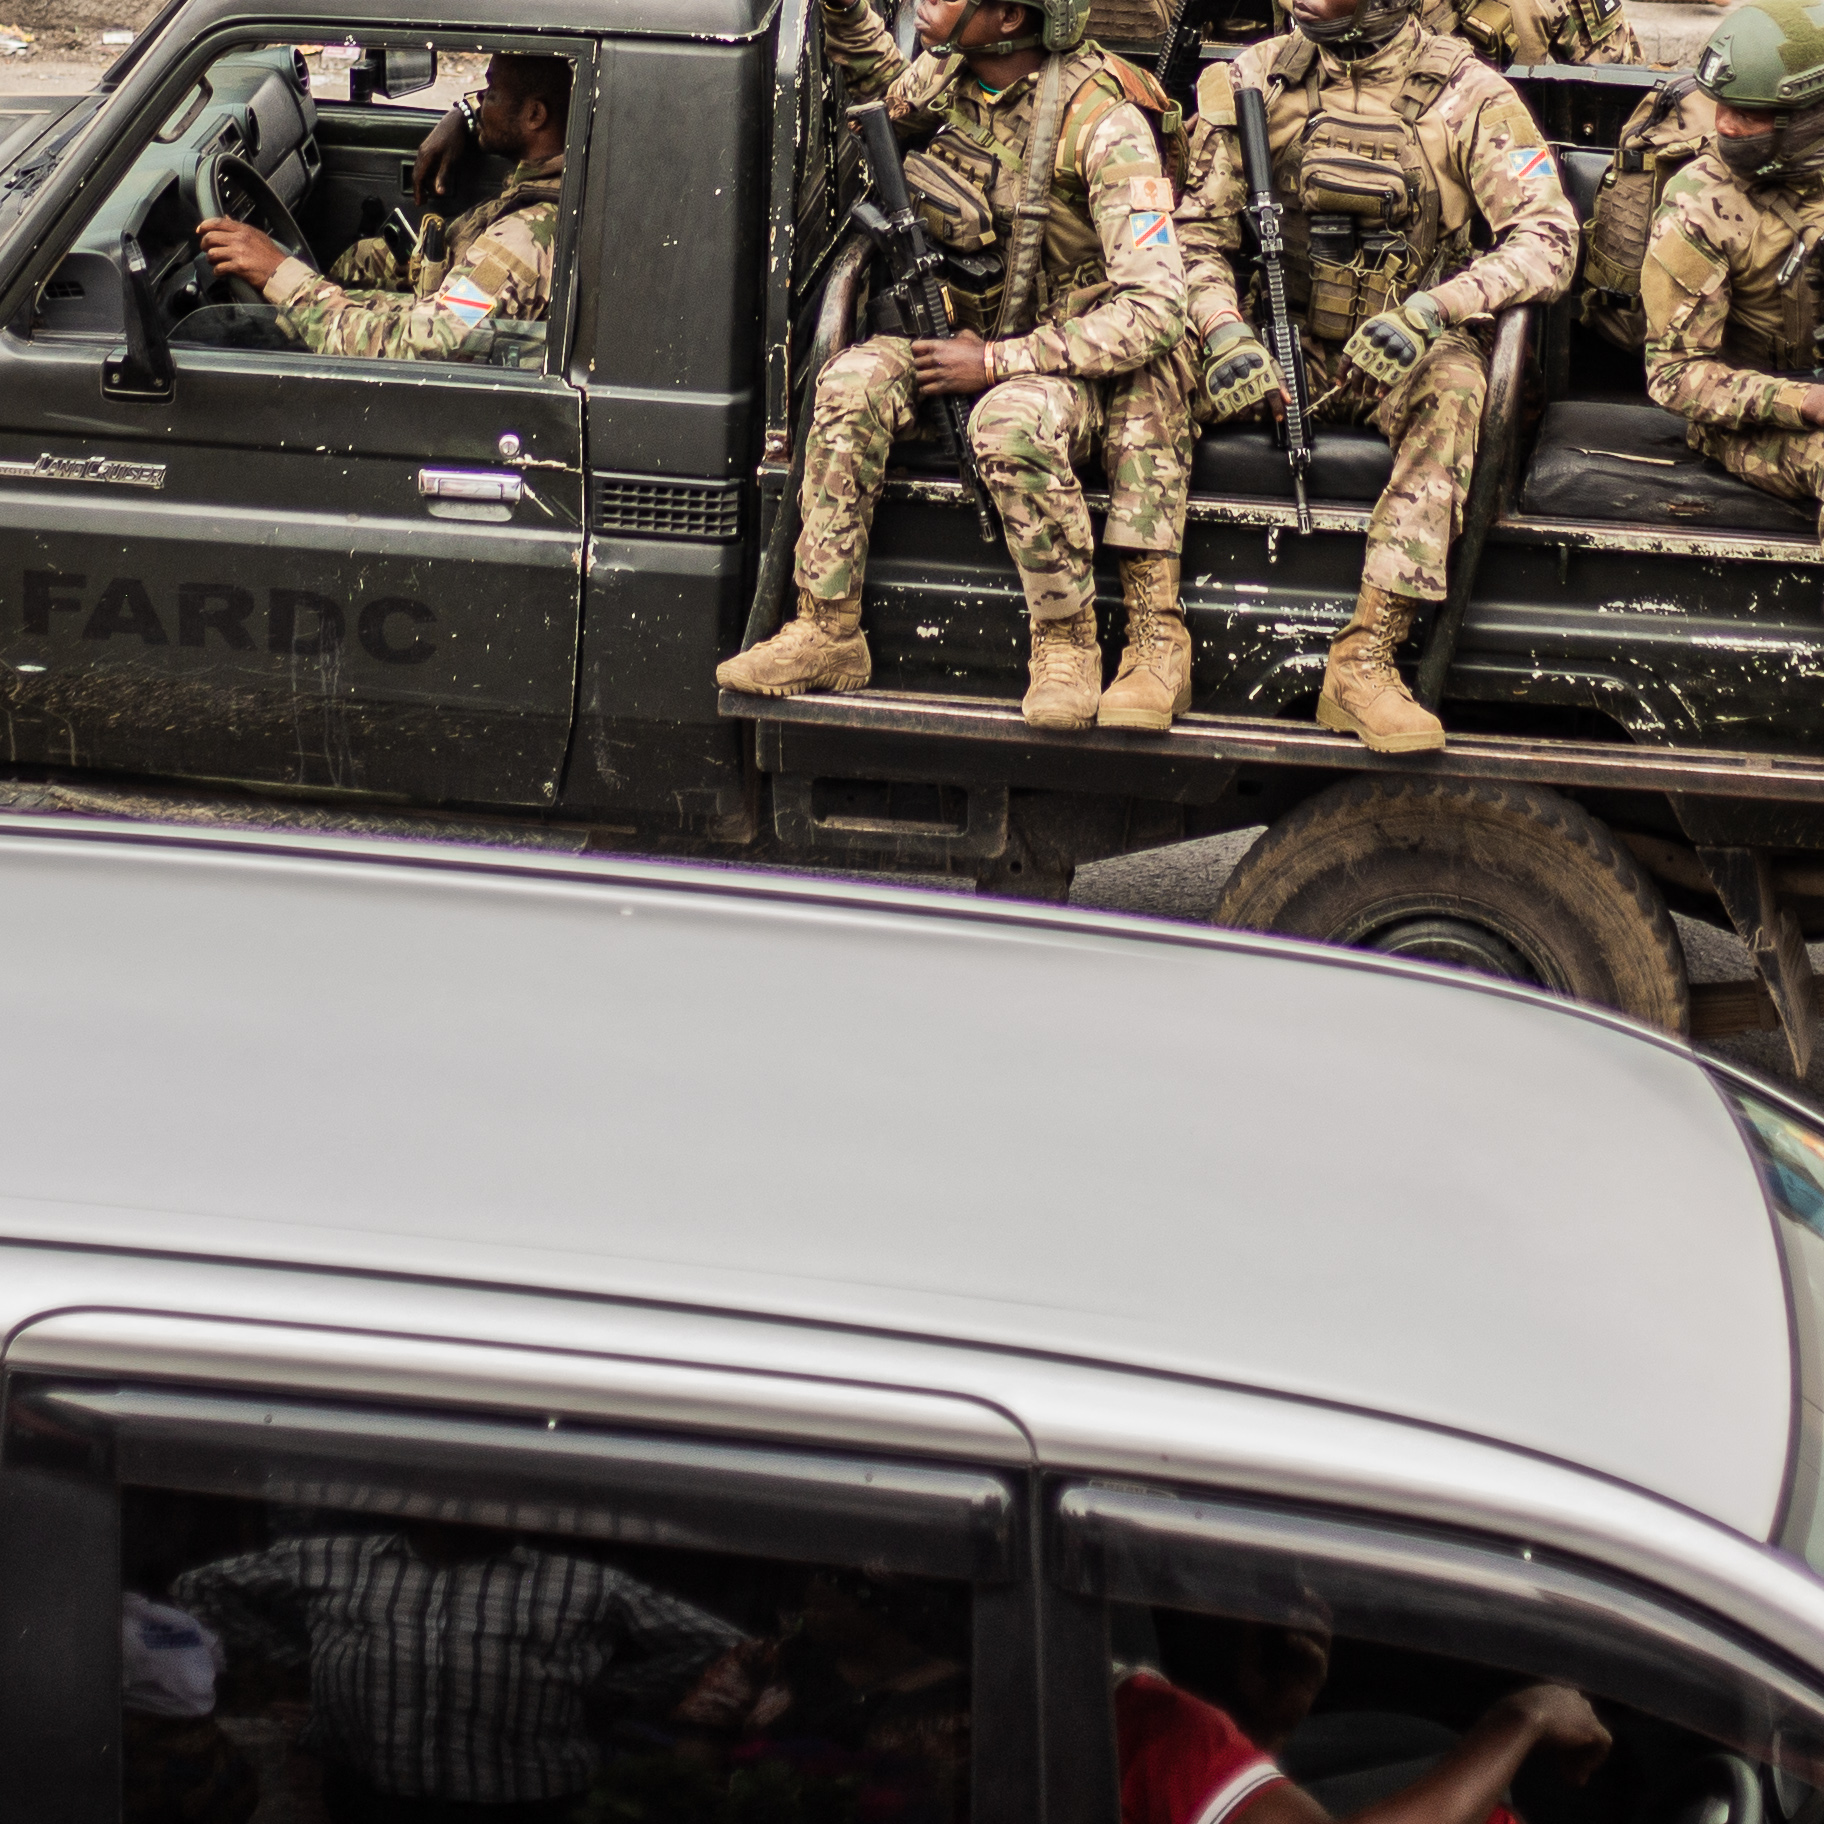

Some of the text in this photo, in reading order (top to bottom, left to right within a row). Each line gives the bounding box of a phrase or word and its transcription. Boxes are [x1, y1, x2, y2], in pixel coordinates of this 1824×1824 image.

[34, 452, 87, 478] LAND
[83, 455, 166, 488] CRUISER
[22, 569, 438, 666] FARDC
